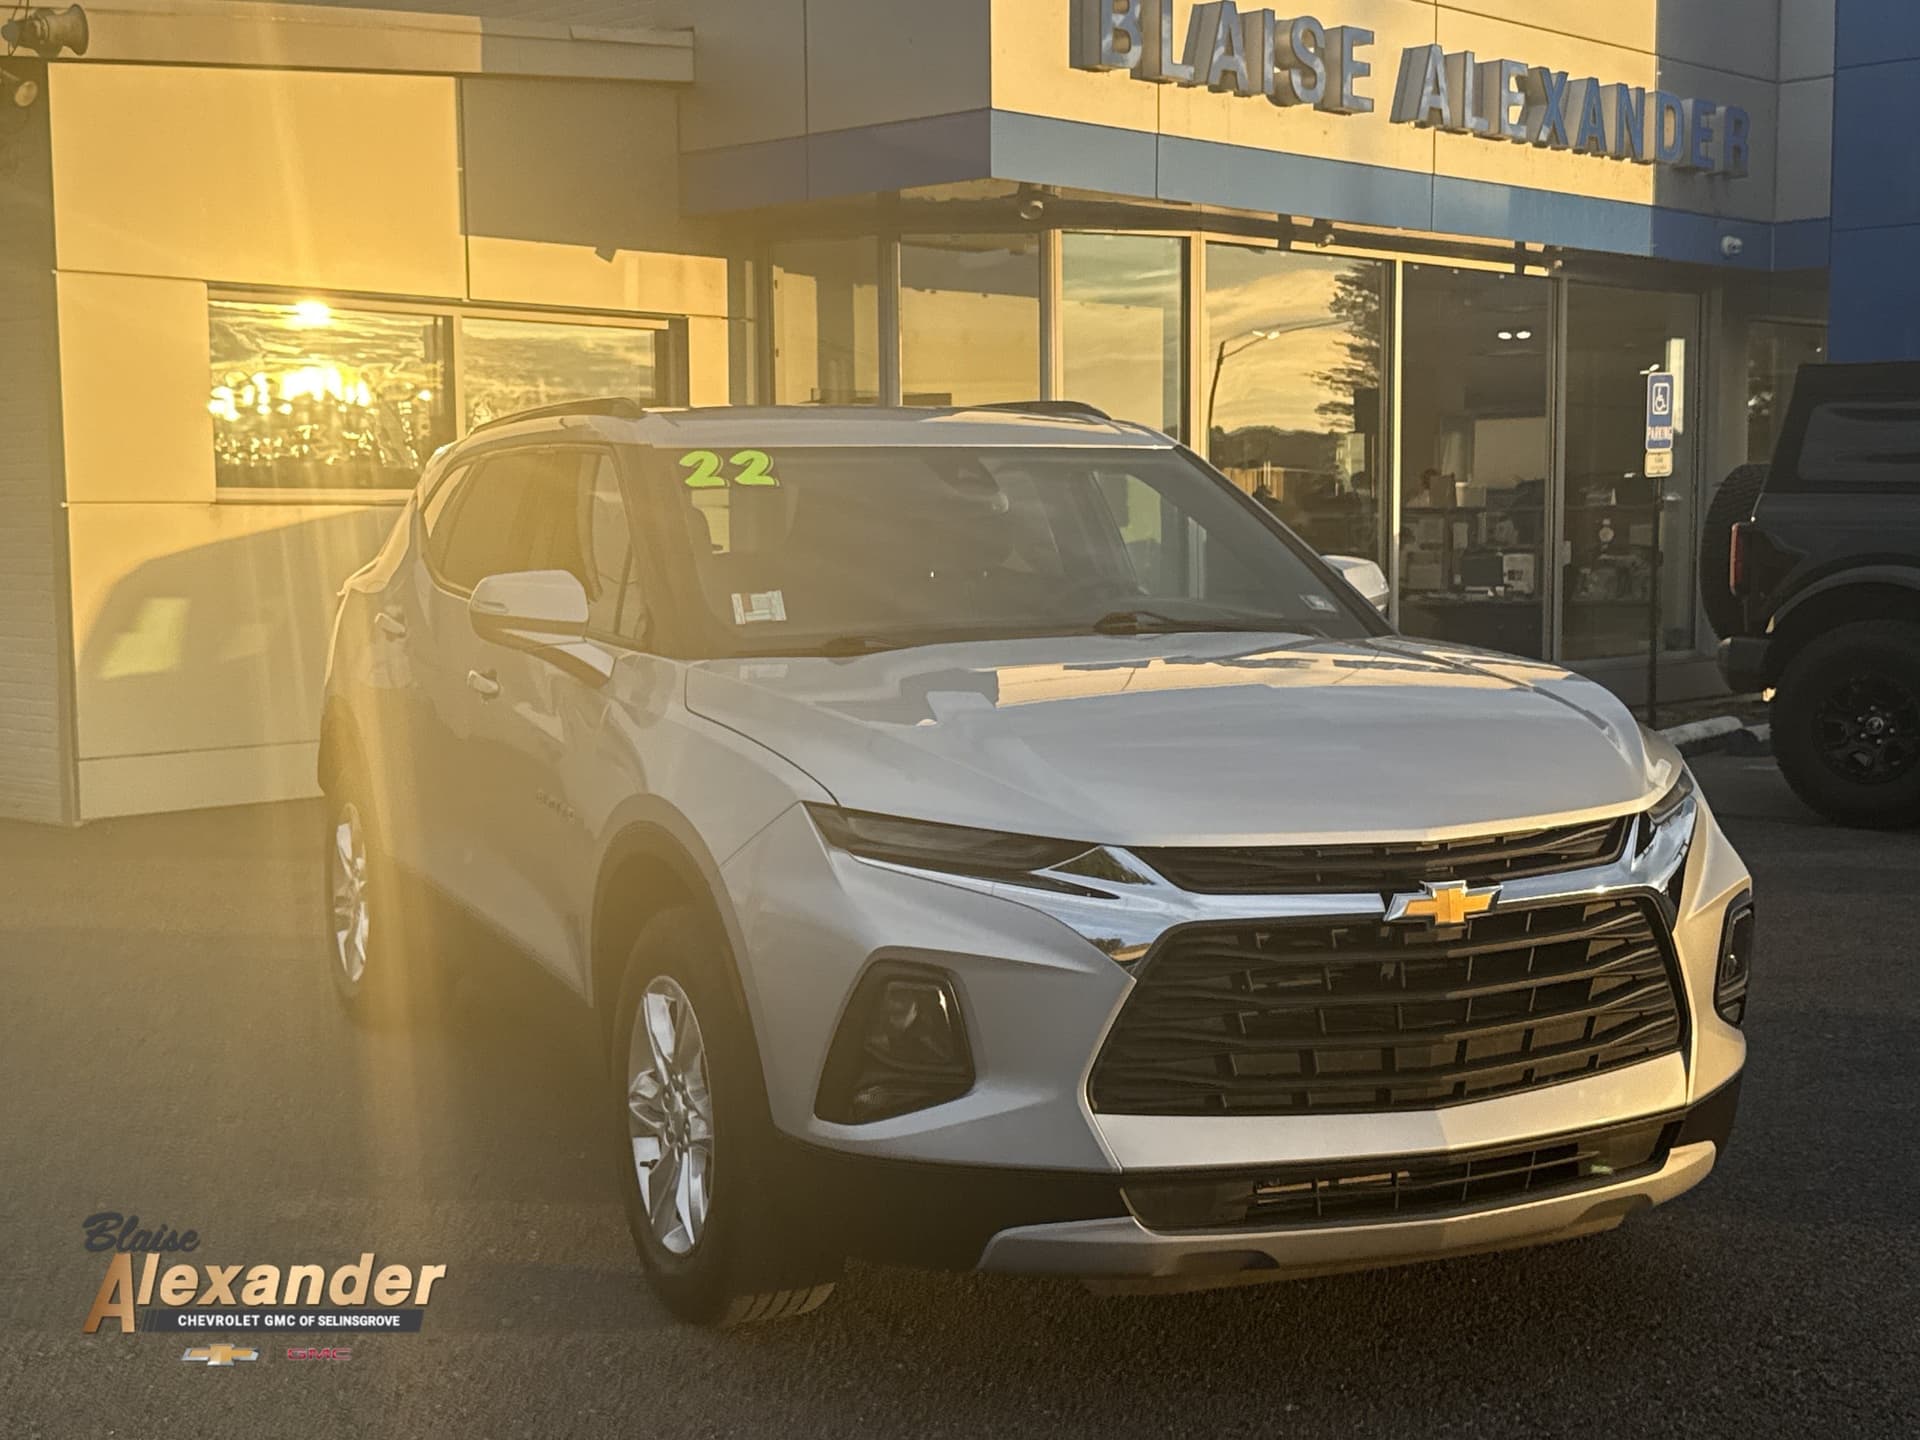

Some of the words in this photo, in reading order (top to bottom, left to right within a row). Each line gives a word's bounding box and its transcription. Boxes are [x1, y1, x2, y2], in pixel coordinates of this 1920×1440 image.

[1074, 0, 1375, 114] BLAISE
[1394, 44, 1752, 178] ALEXANDER
[679, 449, 780, 488] 22
